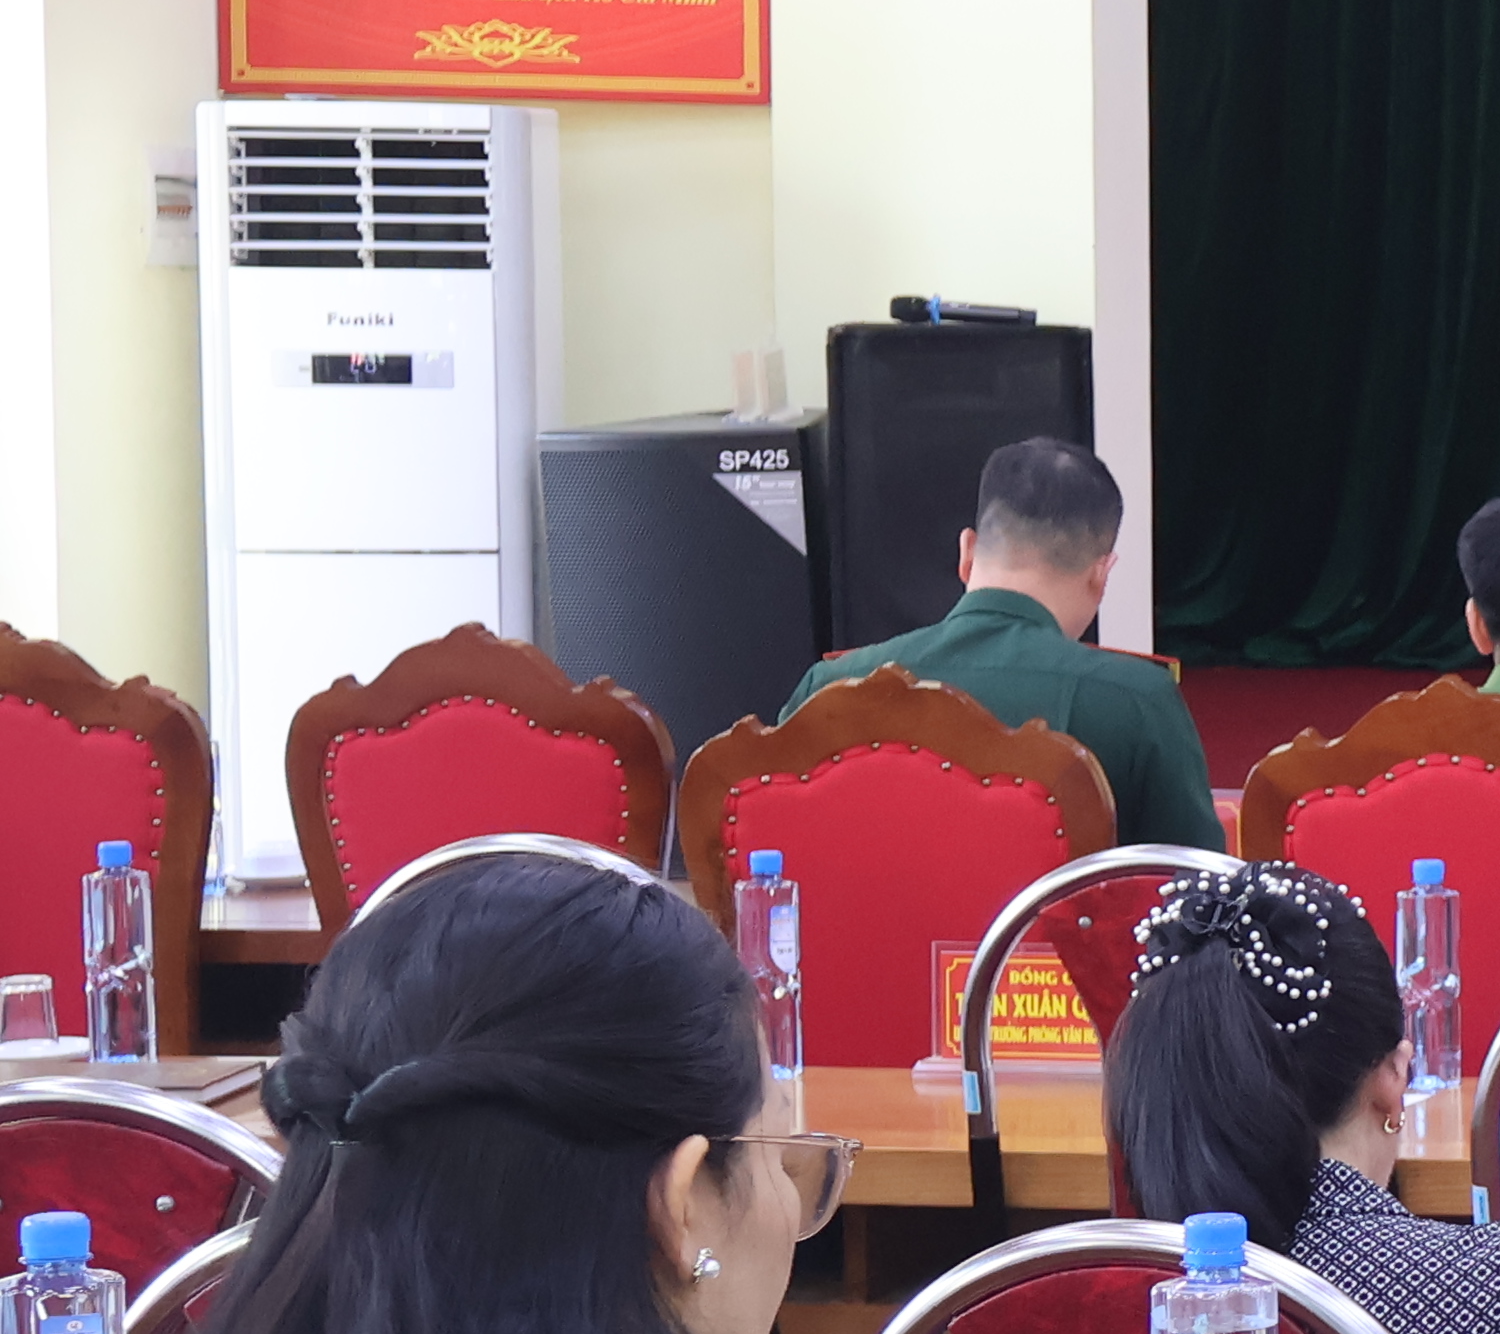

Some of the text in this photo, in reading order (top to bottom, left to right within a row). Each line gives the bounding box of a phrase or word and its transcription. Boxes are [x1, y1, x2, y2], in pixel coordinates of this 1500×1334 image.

[326, 311, 395, 327] Funiki
[718, 448, 790, 472] SP425
[1012, 989, 1068, 1019] XUÂN
